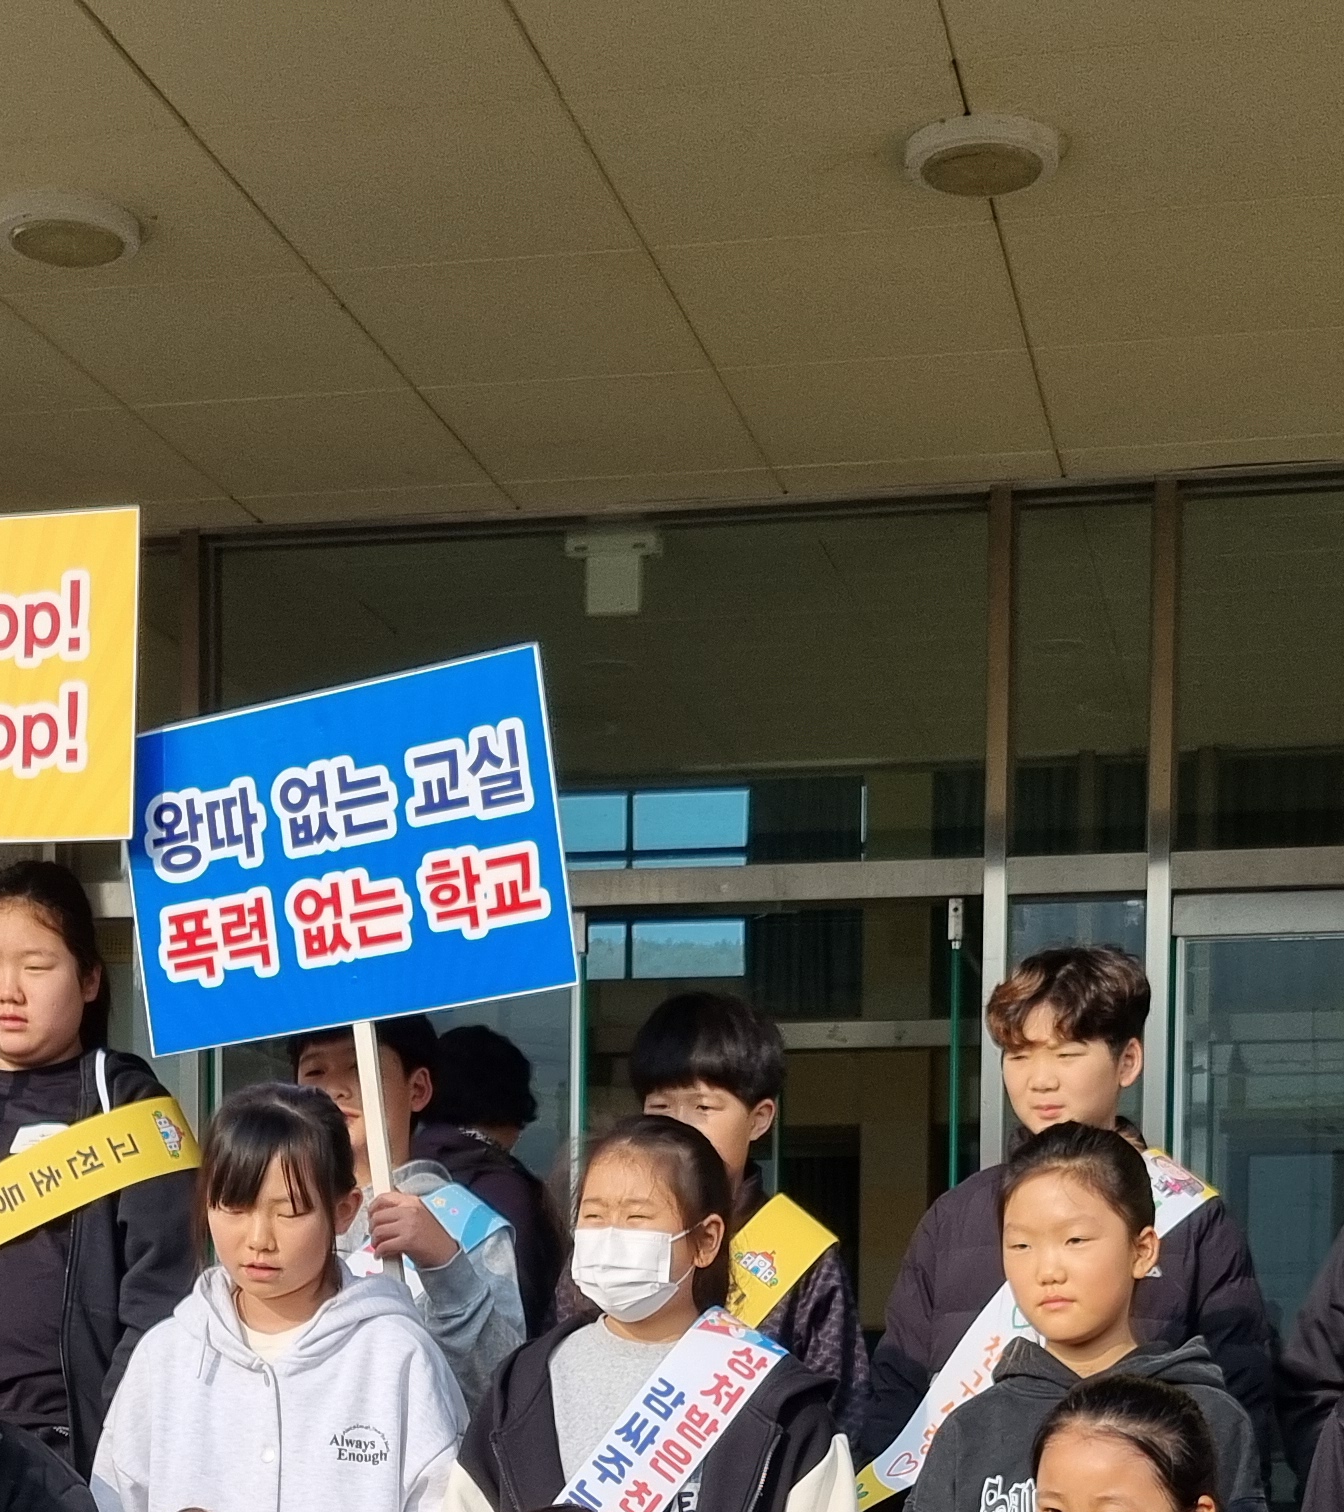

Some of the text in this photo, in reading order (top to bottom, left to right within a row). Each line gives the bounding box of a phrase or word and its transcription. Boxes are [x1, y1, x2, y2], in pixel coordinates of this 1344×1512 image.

[153, 727, 527, 876] 왕따 없는 교실
[165, 850, 545, 980] 폭력 없는 학교
[330, 1434, 375, 1453] Always
[337, 1448, 388, 1466] Enough
[650, 1347, 768, 1483] 상처받은
